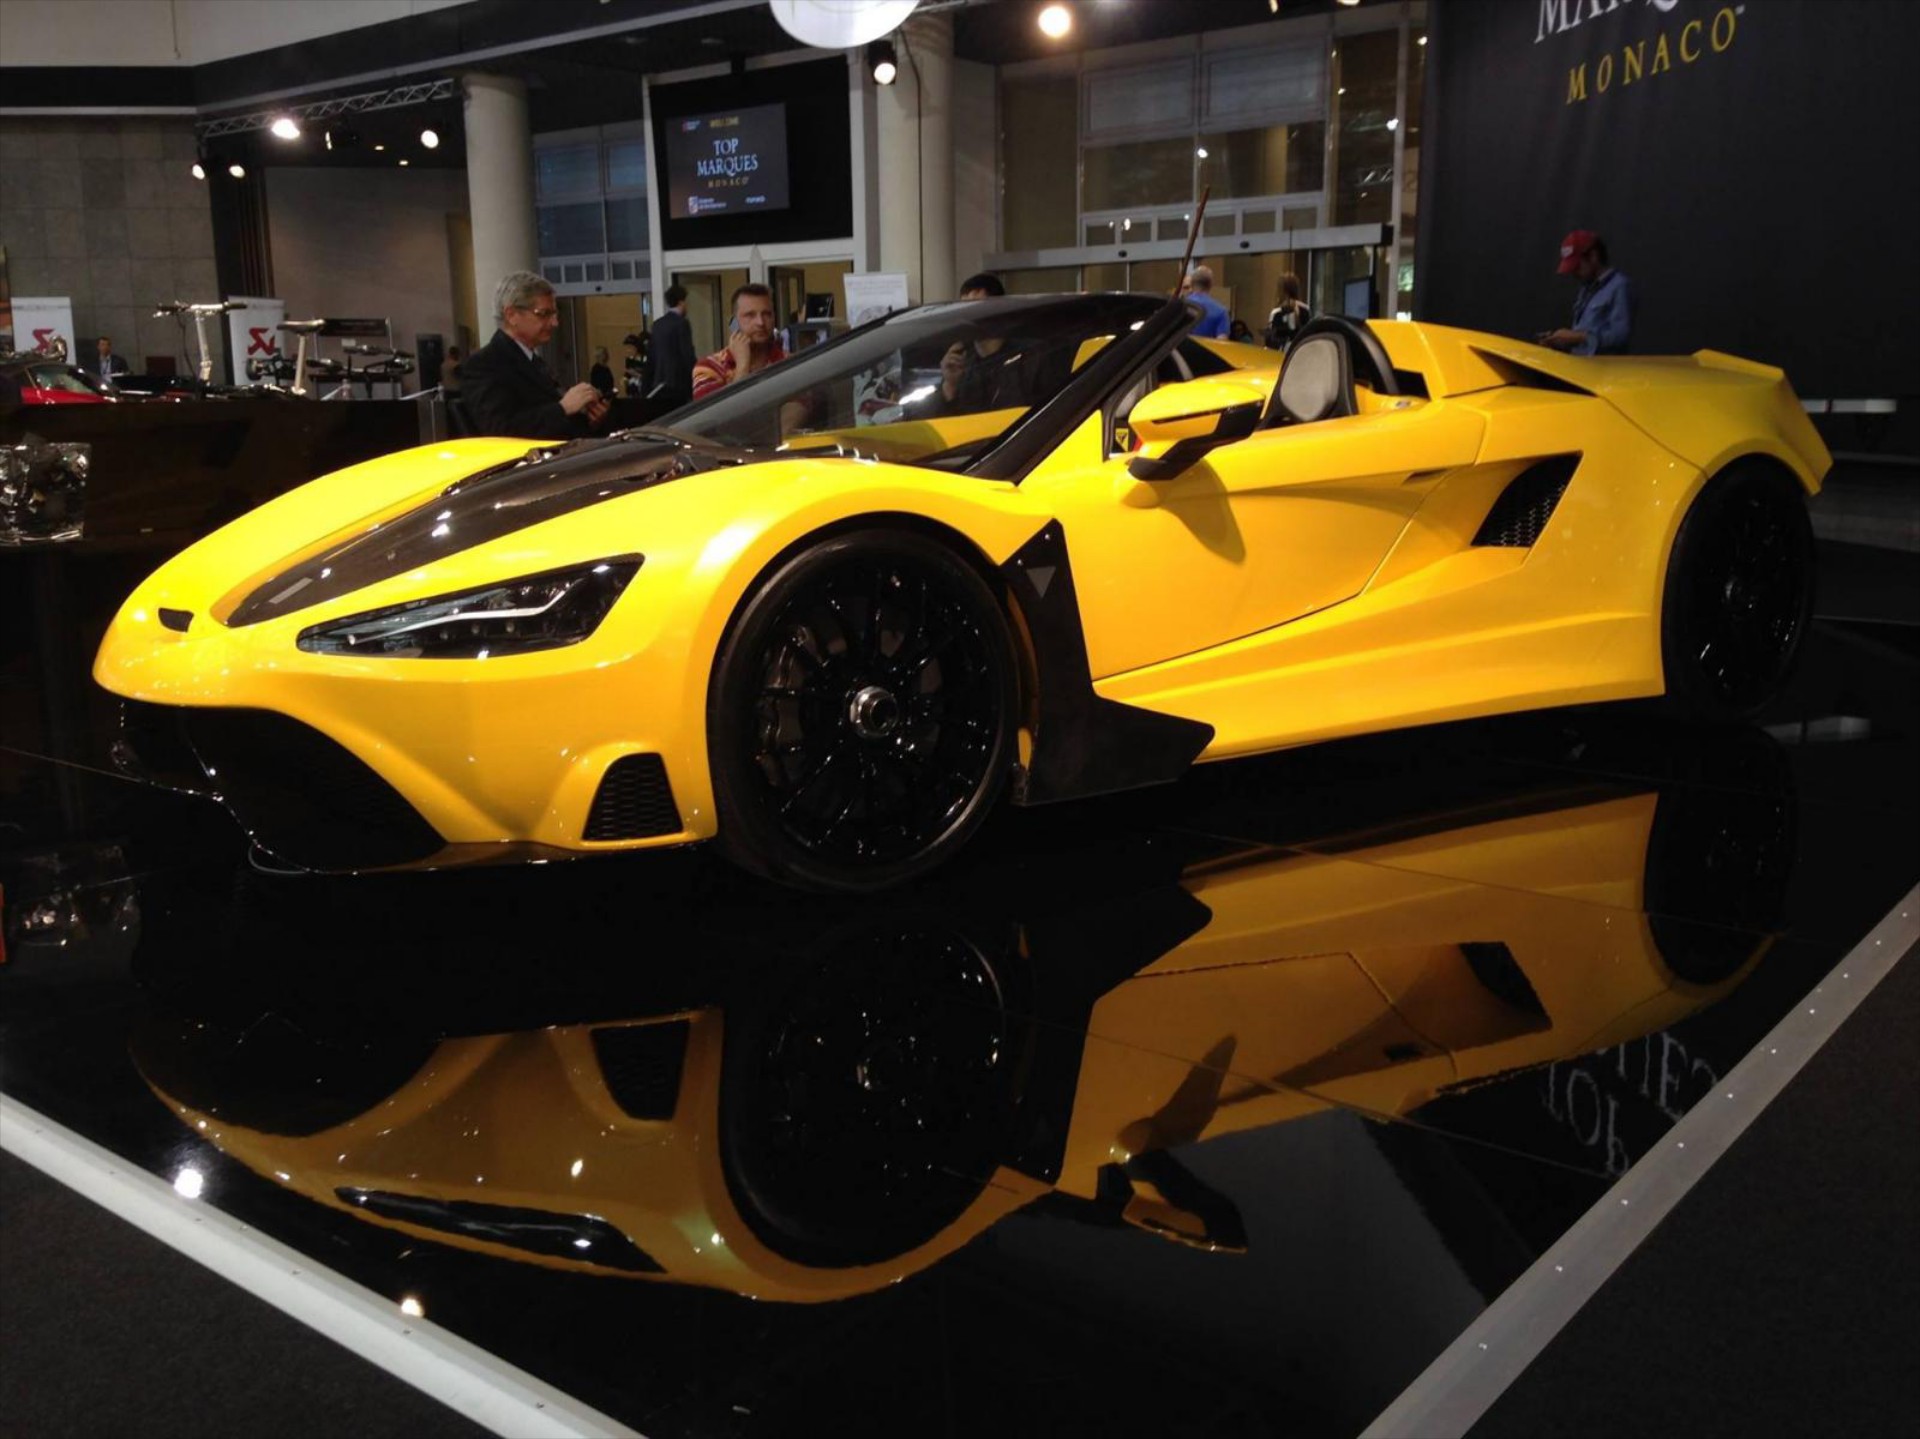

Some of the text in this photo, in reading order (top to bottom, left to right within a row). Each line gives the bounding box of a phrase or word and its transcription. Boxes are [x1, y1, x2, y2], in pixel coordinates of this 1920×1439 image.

[1566, 7, 1736, 104] MONACO
[713, 138, 739, 155] TOP
[697, 154, 758, 176] MARQUES
